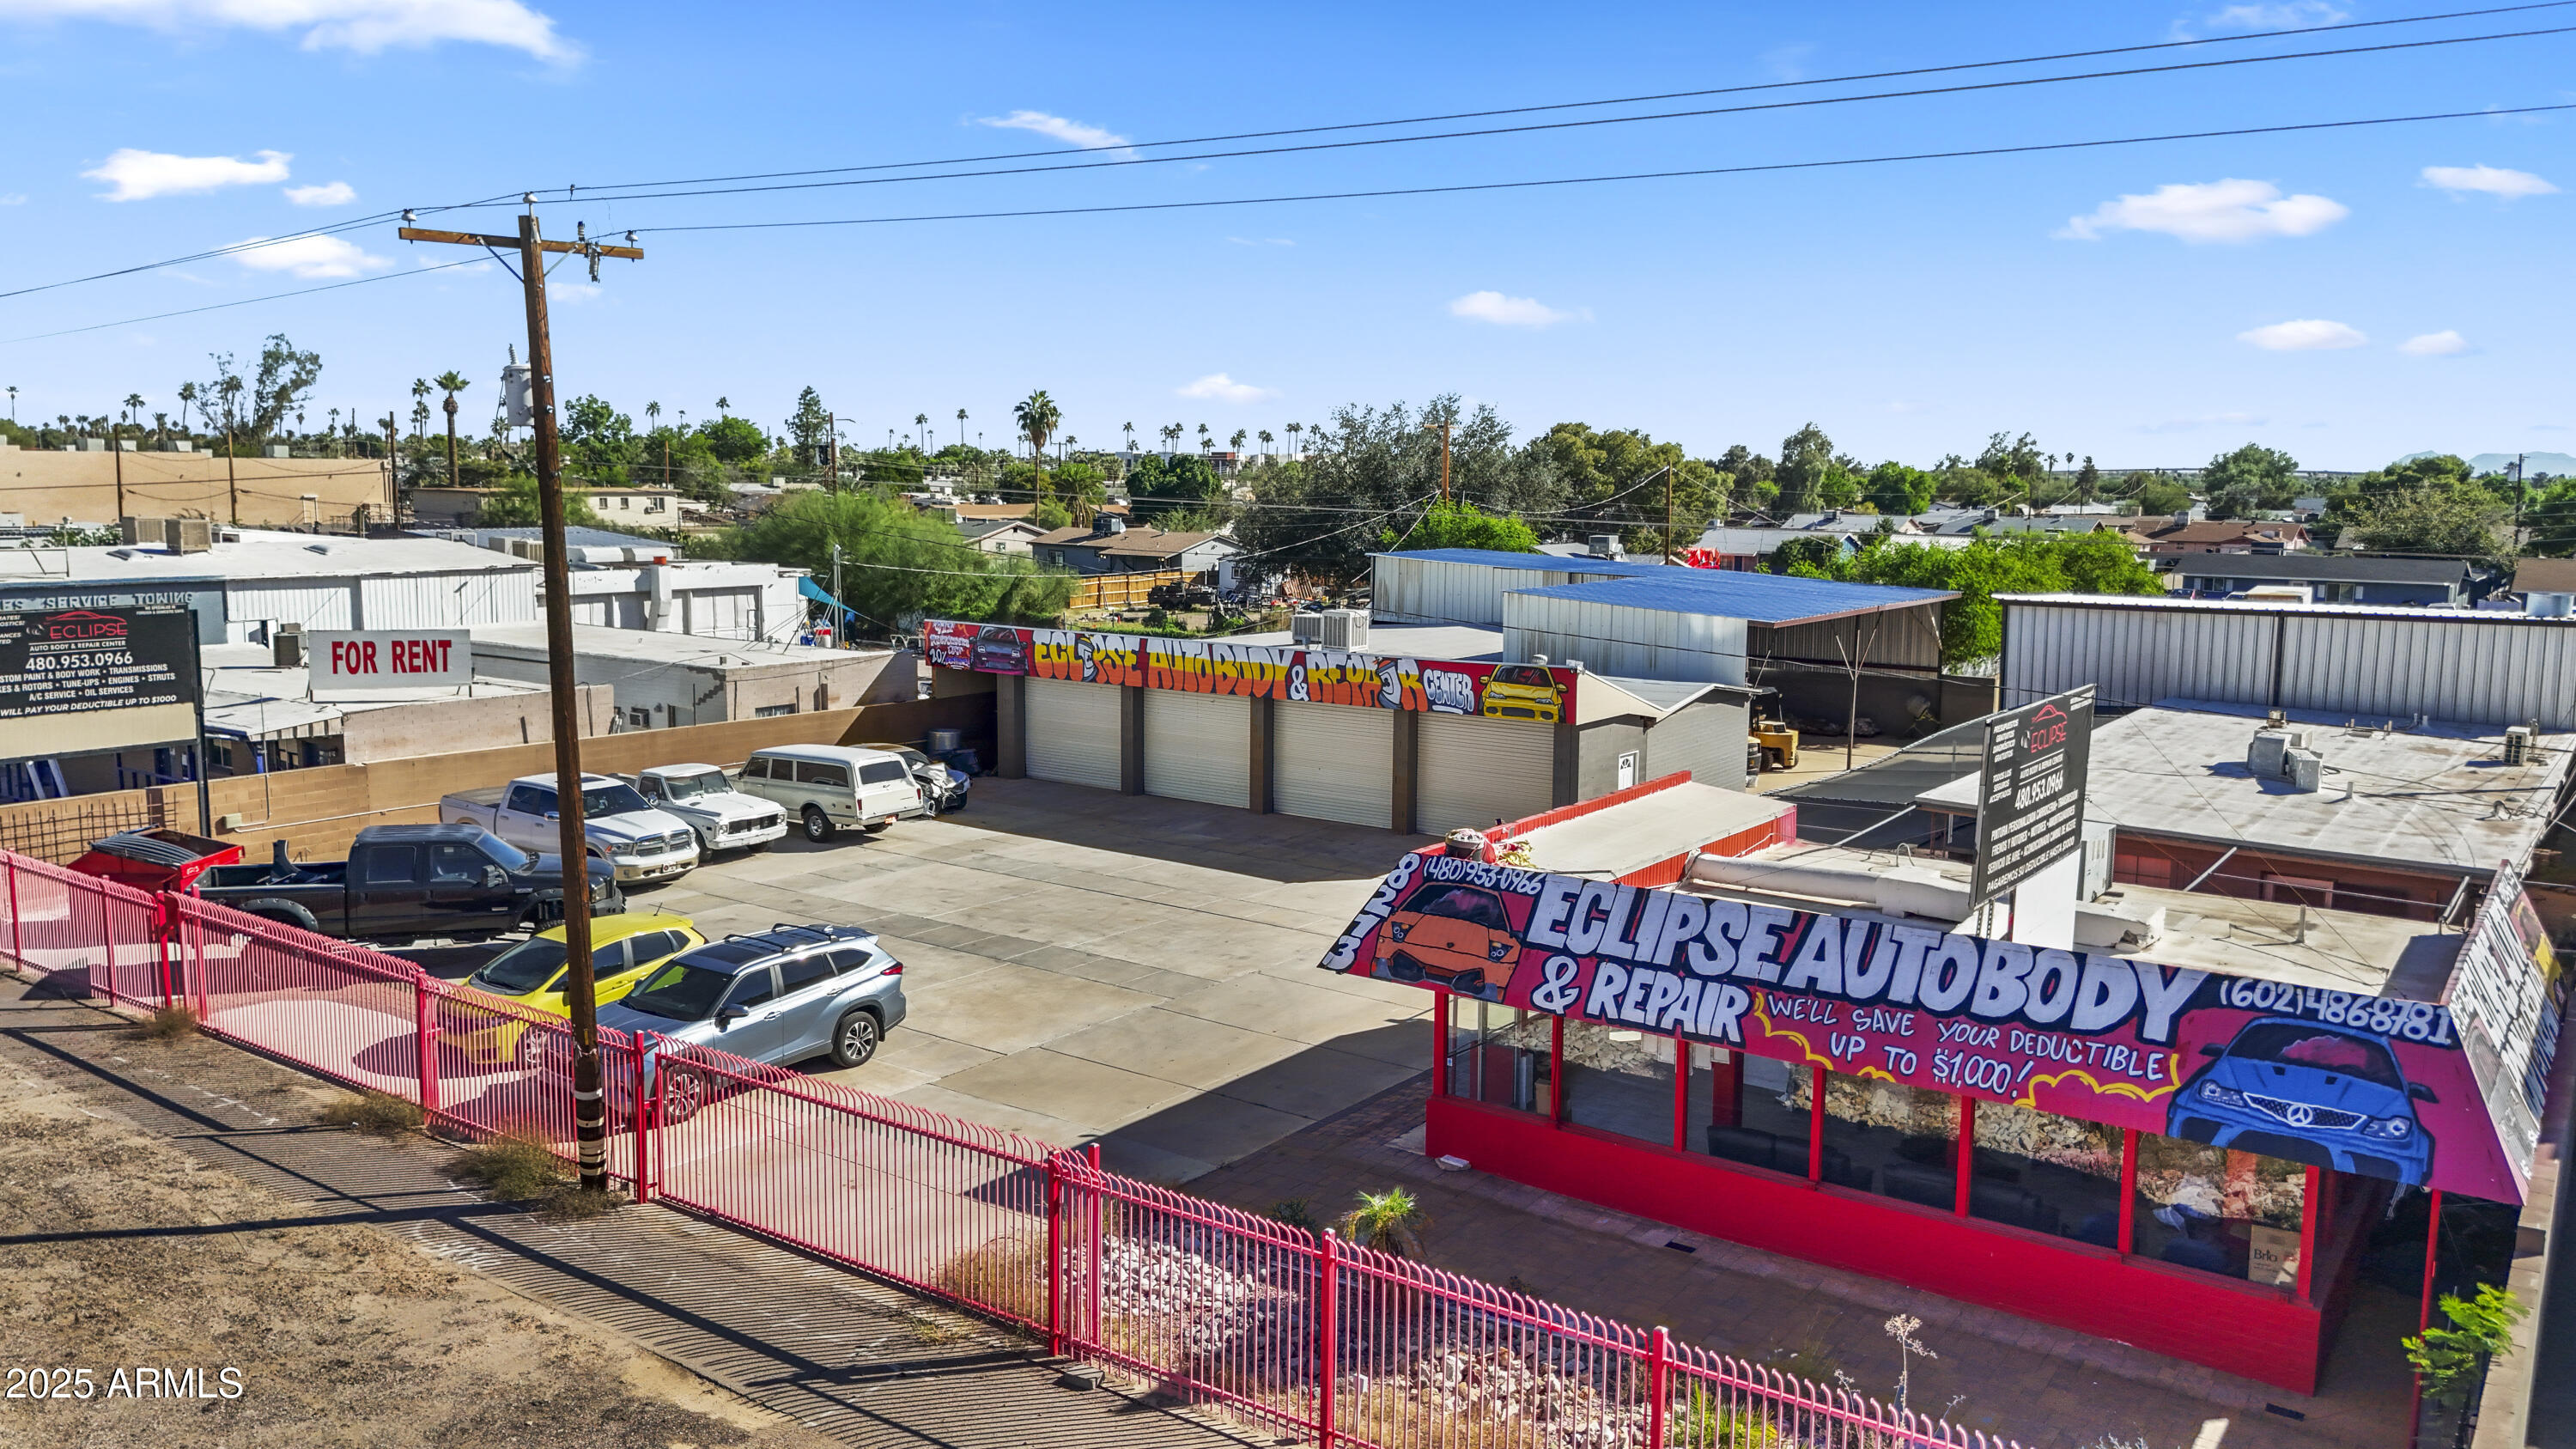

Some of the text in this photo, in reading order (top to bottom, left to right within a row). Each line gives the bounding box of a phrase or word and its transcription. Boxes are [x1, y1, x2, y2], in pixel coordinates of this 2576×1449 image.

[44, 594, 118, 609] SERVICE
[50, 623, 128, 639] ECLIPSE
[23, 673, 46, 681] PAINT
[55, 670, 76, 679] BODY
[77, 668, 101, 677] WORK
[109, 663, 168, 674] TRANSMISSIONS
[25, 651, 133, 671] 480.953.0966
[331, 640, 452, 675] FOR RENT
[21, 682, 53, 691] ROTORS
[62, 679, 100, 688] TUNE-UPS
[108, 675, 139, 685] ENGINES
[148, 673, 176, 682] STRUTS
[29, 693, 43, 702] A/C
[45, 690, 76, 700] SERVICE
[99, 685, 134, 696] SERVICES
[1290, 665, 1309, 703] &
[1423, 668, 1476, 713] CENTER
[0, 708, 22, 716] WILL
[25, 706, 43, 715] PAY
[44, 703, 70, 712] YOUR
[70, 699, 124, 710] DEDUCTIBLE
[151, 695, 177, 703] $1000
[2031, 721, 2068, 753] ECLIPSE
[2014, 770, 2063, 810] 480.953.0966
[1423, 856, 1542, 895] (480)953-0966
[1320, 853, 1420, 970] 8213
[1527, 873, 1798, 984] ECLIPSE
[1532, 955, 1749, 1043] & REPAIR
[1767, 993, 2164, 1081] WE'LL SAVE YOUR DEDUCTIBLE
[1830, 1033, 2034, 1099] UP TO $1,000!
